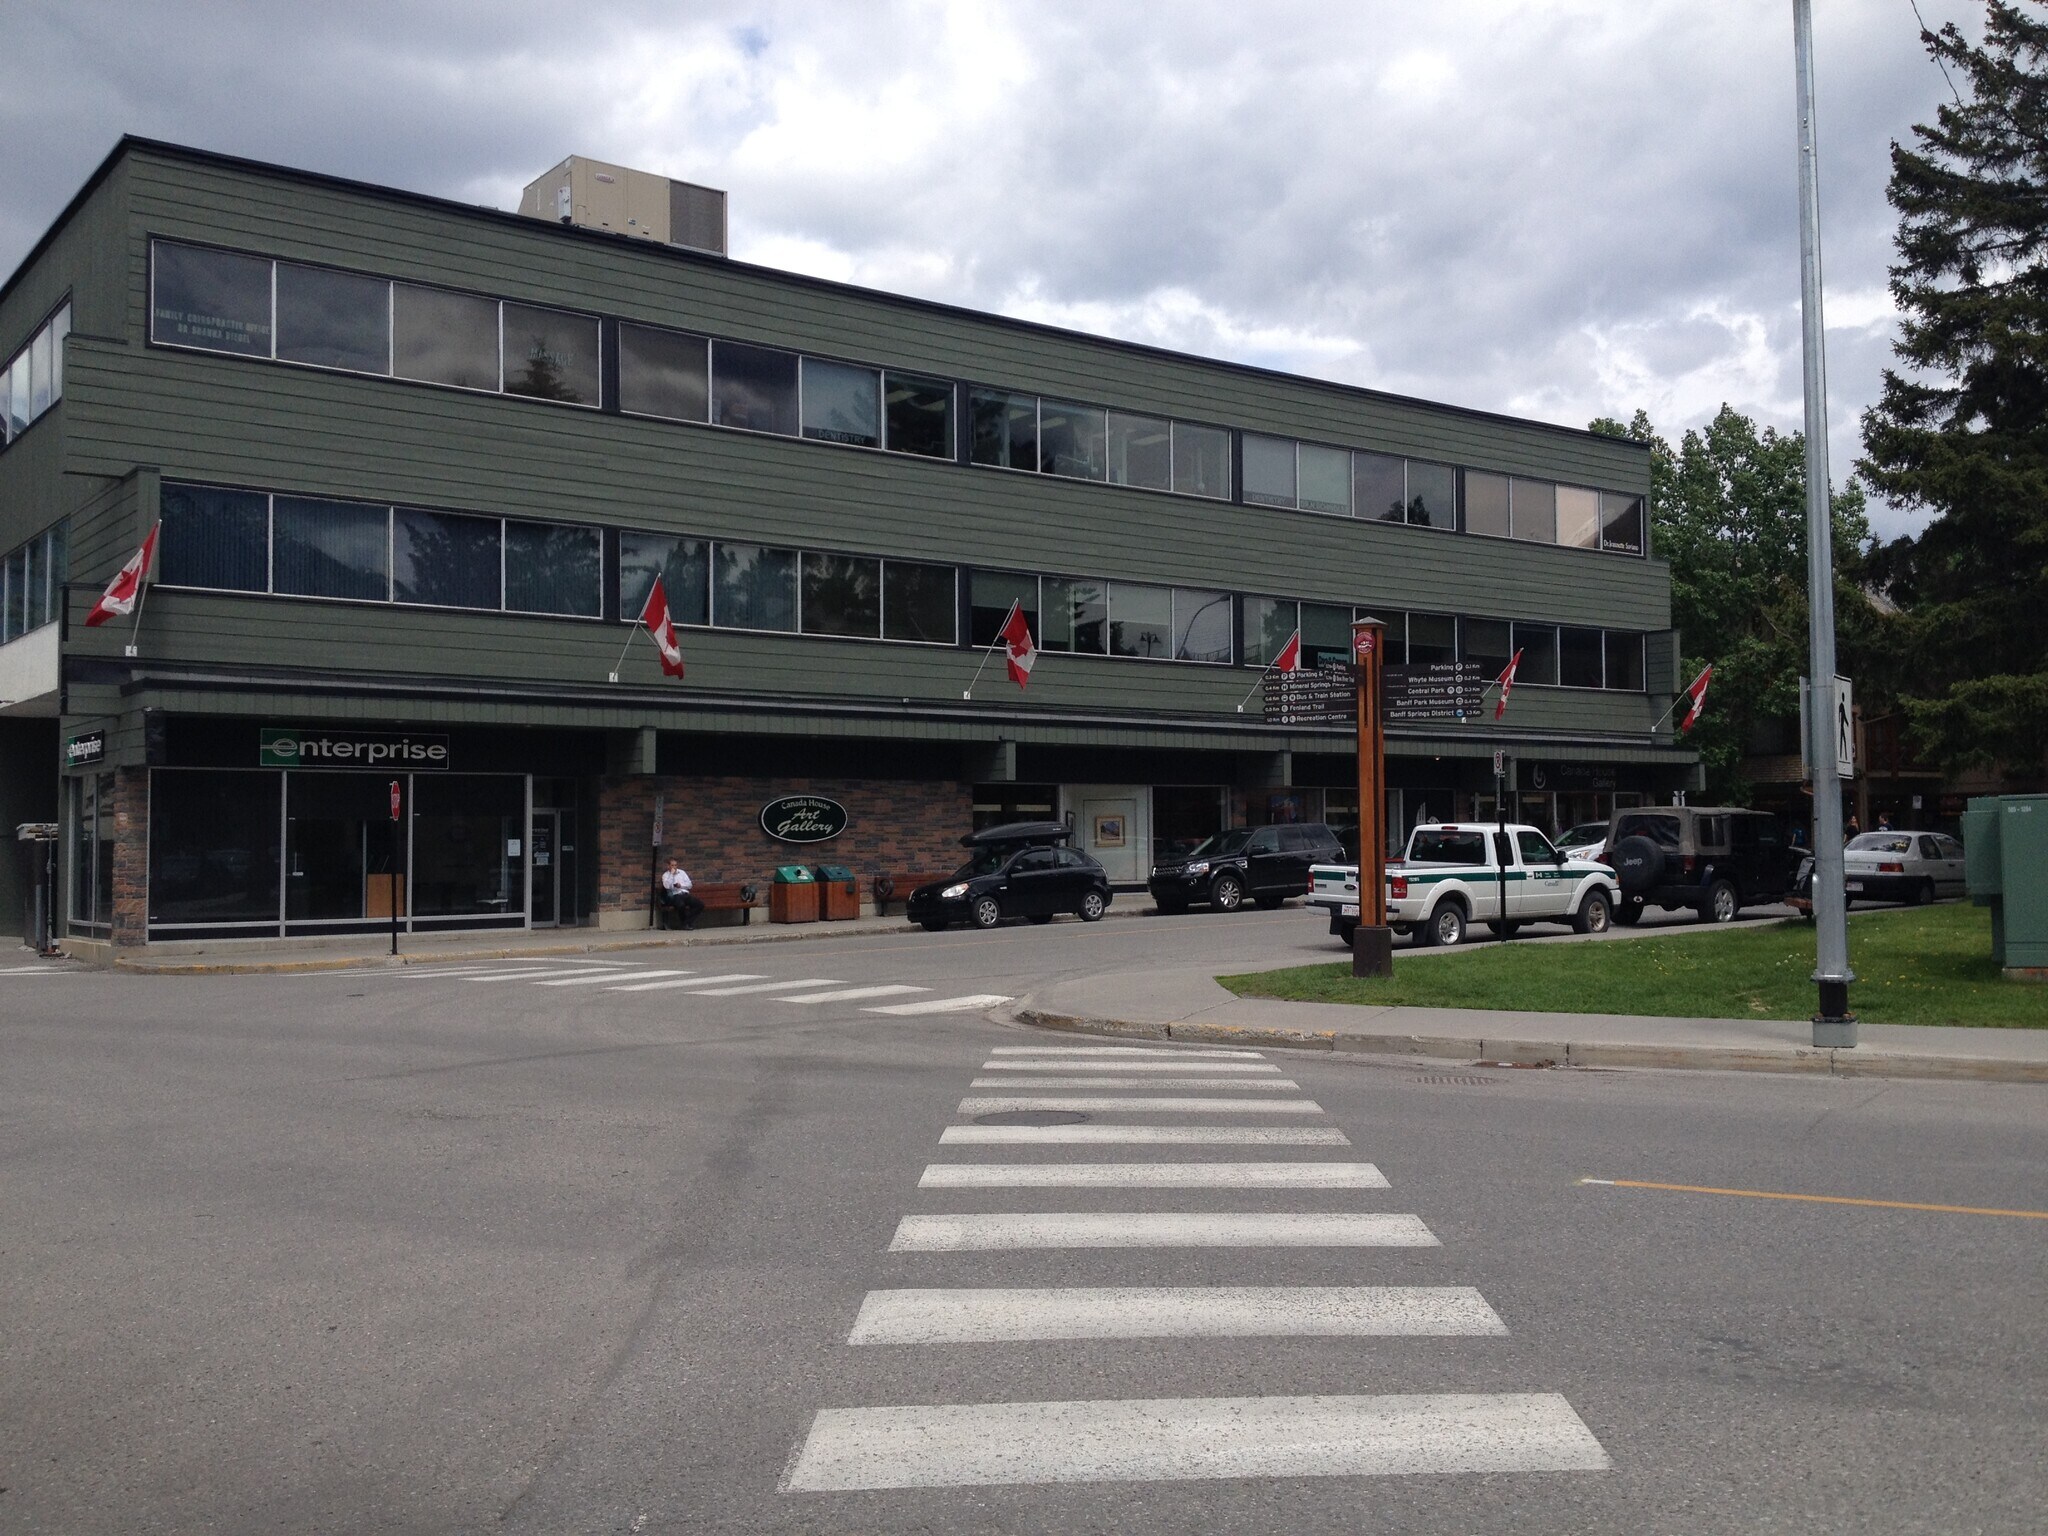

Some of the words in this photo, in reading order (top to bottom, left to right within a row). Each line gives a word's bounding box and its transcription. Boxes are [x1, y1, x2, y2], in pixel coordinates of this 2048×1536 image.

[818, 429, 865, 444] DENTISTRY
[272, 738, 448, 764] enterprise
[781, 799, 807, 810] Canada
[808, 799, 831, 811] House
[791, 808, 820, 820] Art
[777, 820, 834, 836] Gallery
[1624, 858, 1642, 866] Jeep
